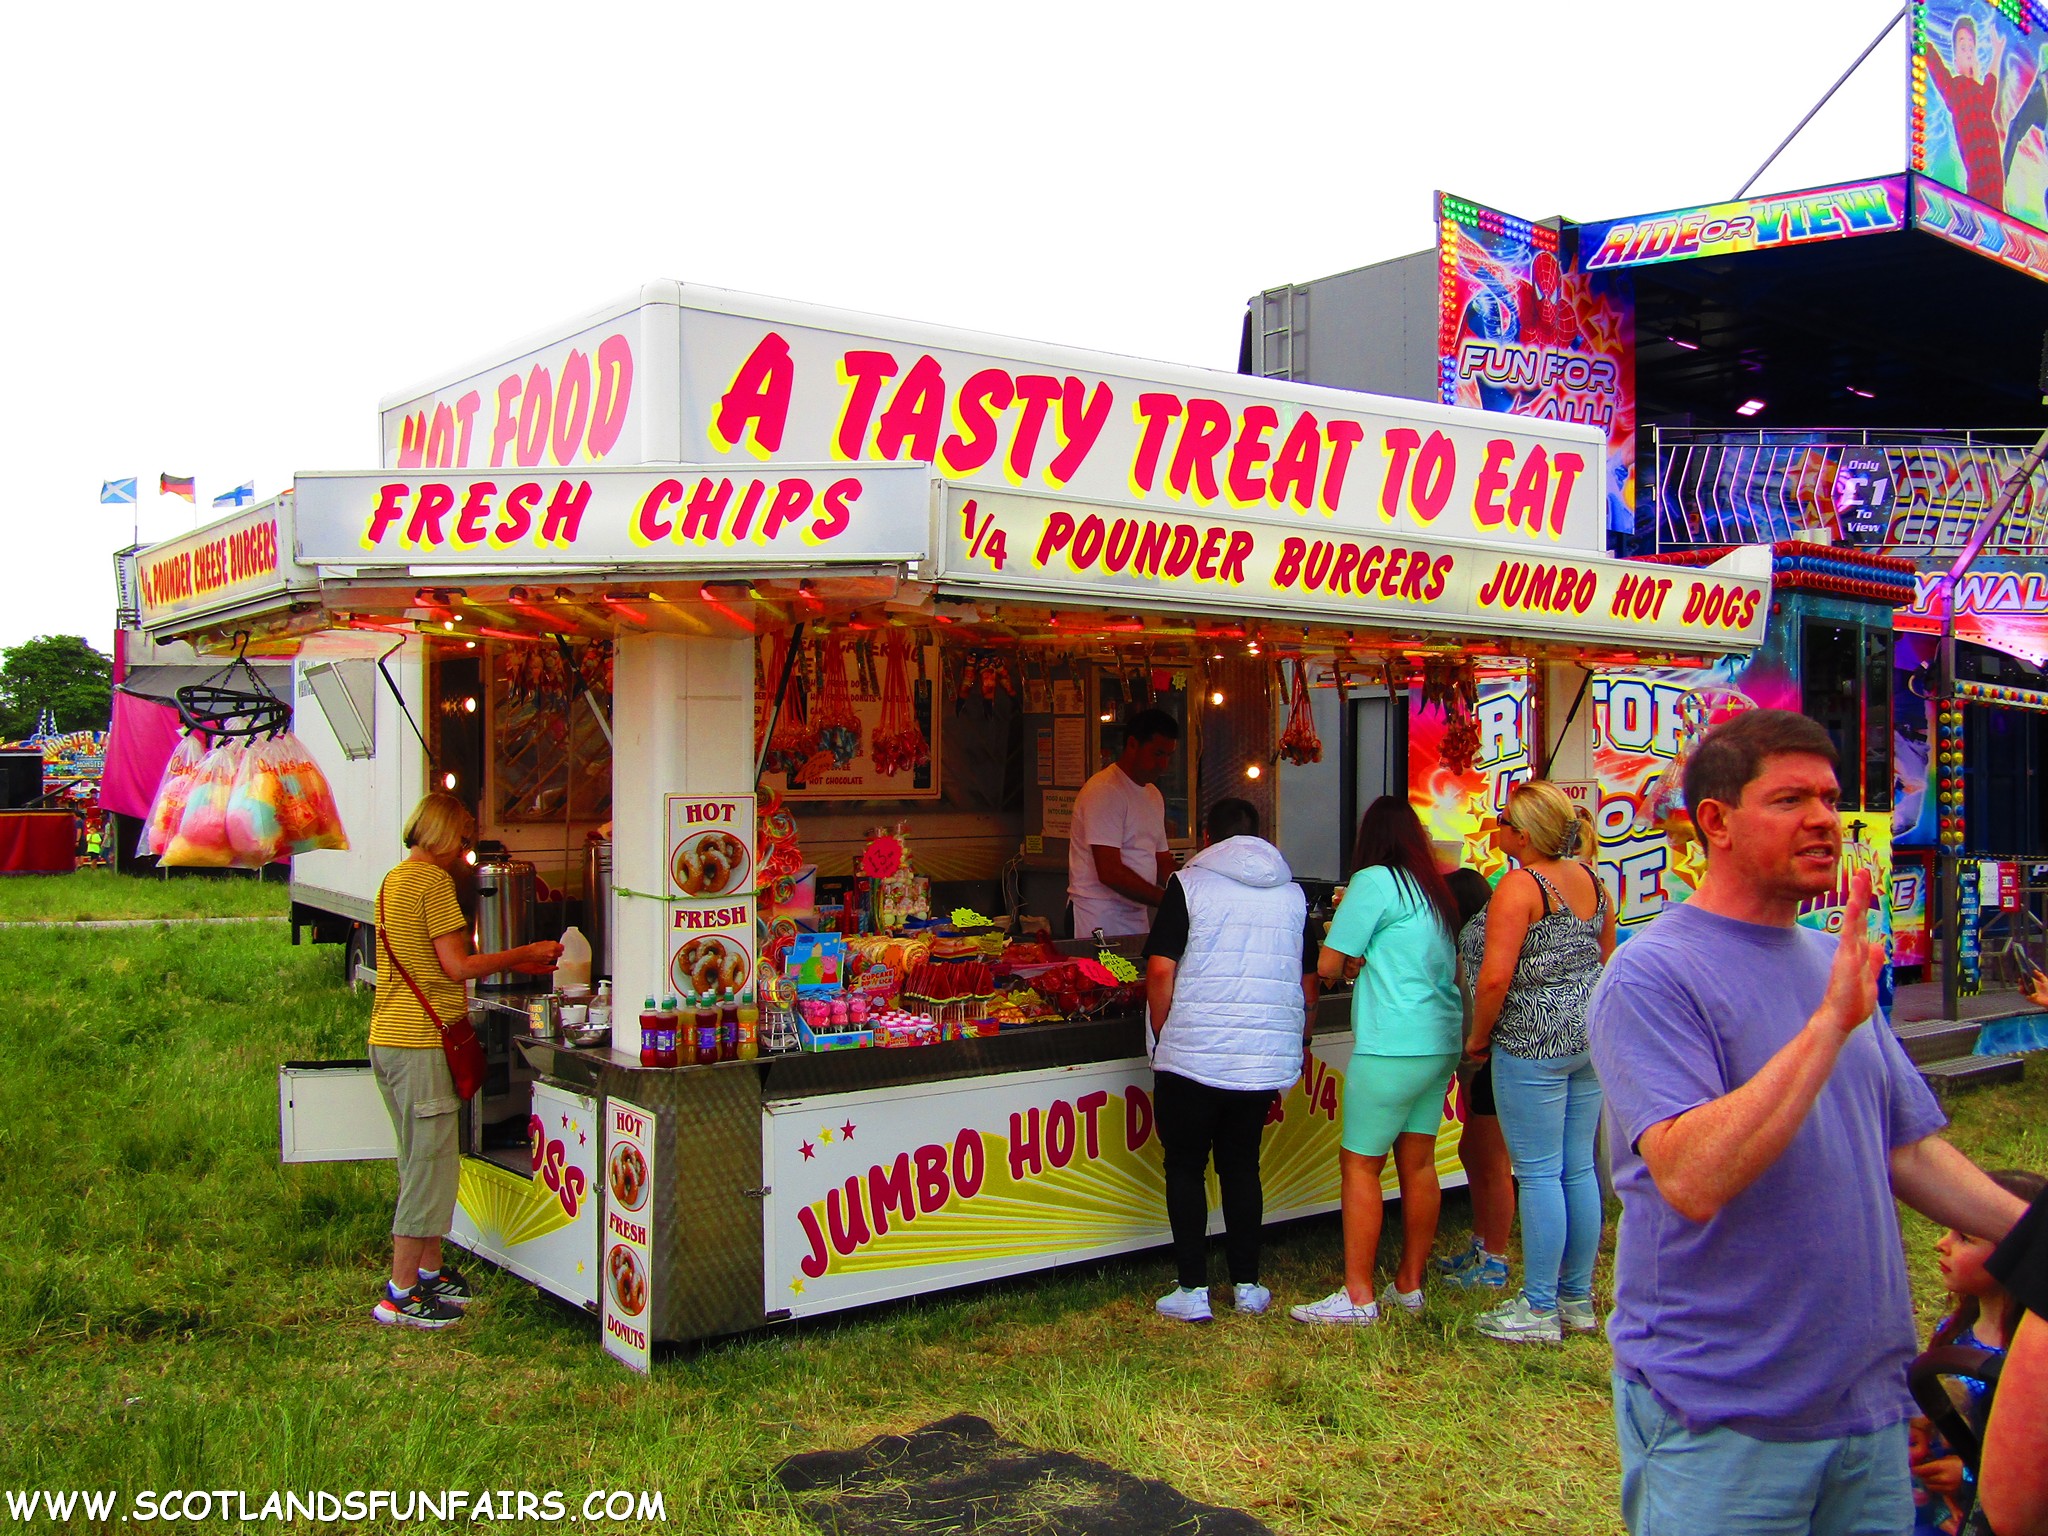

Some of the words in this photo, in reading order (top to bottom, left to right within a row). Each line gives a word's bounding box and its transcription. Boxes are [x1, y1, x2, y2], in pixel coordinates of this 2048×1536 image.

[1587, 214, 1706, 270] RIDE
[1700, 216, 1753, 245] OR
[1751, 187, 1899, 246] VIEW
[1460, 345, 1538, 384] FUN
[1542, 350, 1616, 394] FOR
[397, 389, 482, 468] HOT
[489, 334, 634, 467] FOOD
[708, 331, 794, 454] A
[830, 350, 1113, 491] TASTY
[1129, 392, 1364, 518] TREAT
[1376, 428, 1457, 529] TO
[1470, 438, 1585, 542] EAT
[1848, 459, 1880, 472] Only
[1842, 478, 1888, 506] £1
[360, 479, 592, 551] FRESH
[629, 476, 863, 549] CHIPS
[1847, 522, 1880, 533] View
[1855, 509, 1872, 519] To
[152, 551, 193, 605] POUNDER
[194, 537, 229, 595] CHEESE
[229, 518, 278, 582] BURGERS
[959, 499, 1007, 570] 1/4
[1033, 511, 1254, 588] POUNDER
[1272, 536, 1454, 603] BURGERS
[1476, 560, 1598, 617] JUMBO
[1610, 573, 1672, 622] HOT
[1682, 581, 1762, 630] DOGS
[825, 777, 863, 785] CHOCOLATE
[684, 803, 736, 824] HOT
[673, 905, 747, 930] FRESH
[861, 970, 894, 982] CUPCAKE
[879, 977, 893, 985] LICK
[615, 1111, 643, 1139] HOT
[796, 1128, 985, 1280] JUMBO
[1007, 1089, 1108, 1181] HOT
[608, 1211, 647, 1247] FRESH
[606, 1313, 646, 1352] DONUTS
